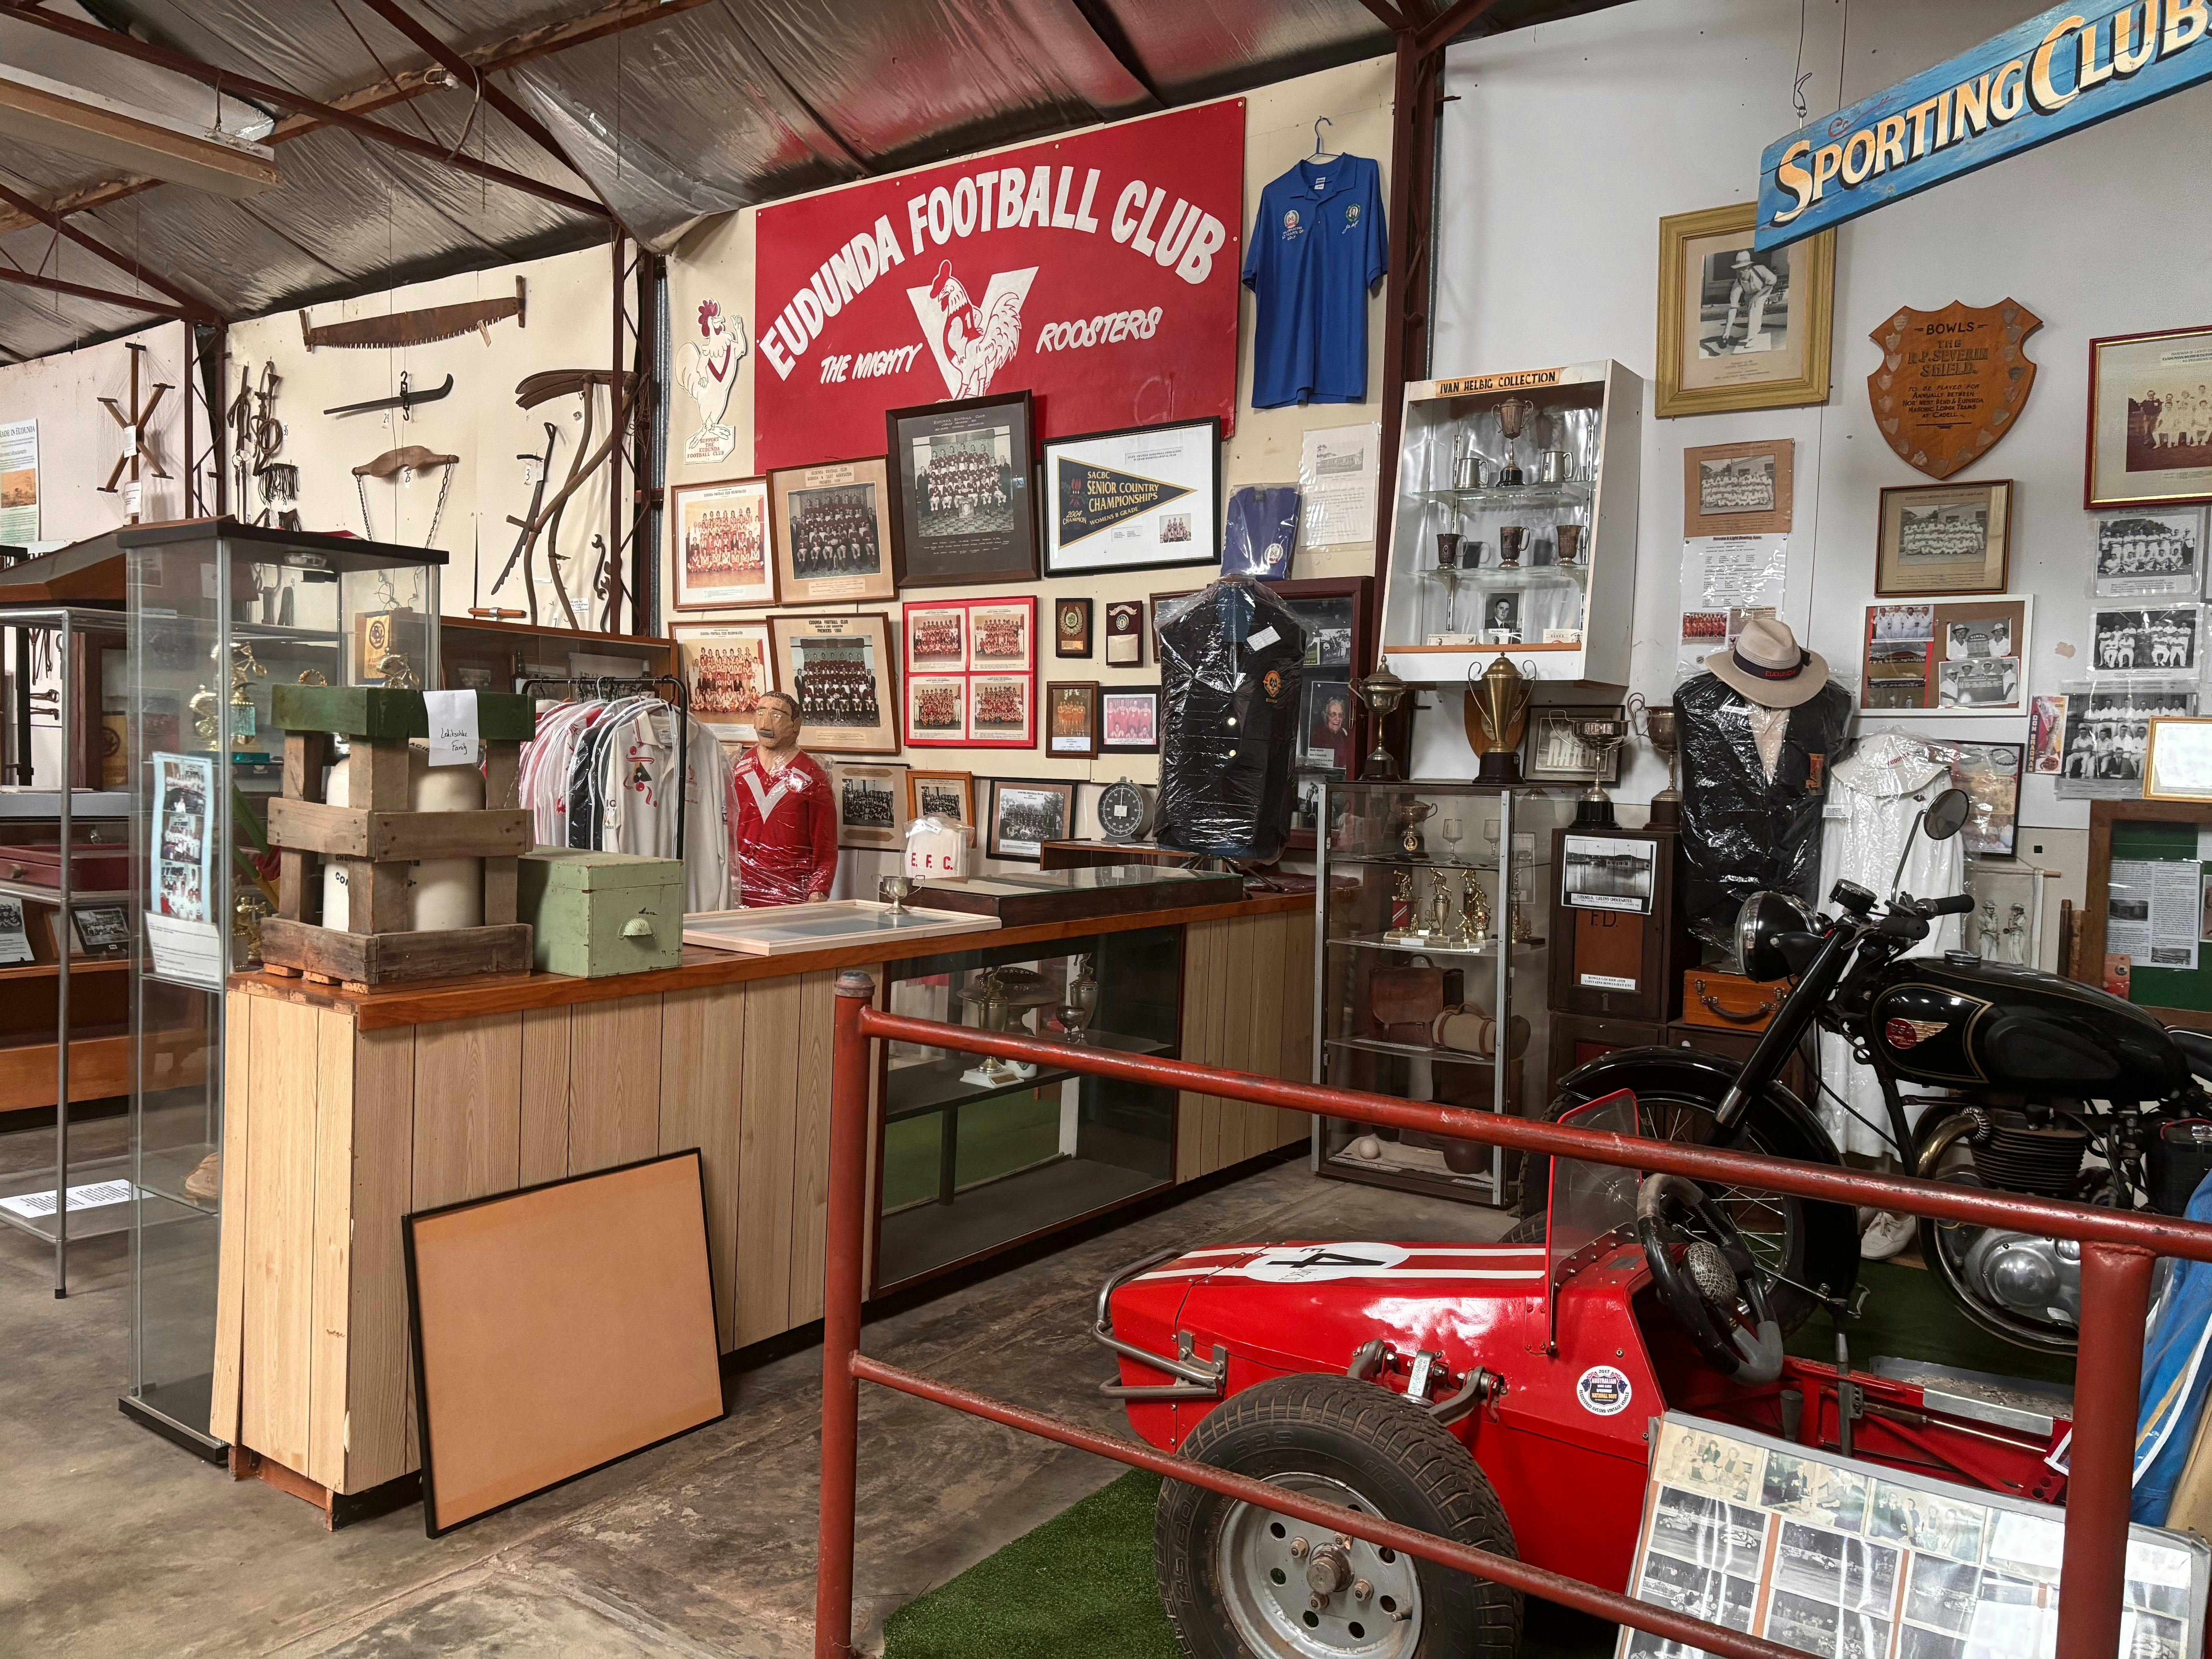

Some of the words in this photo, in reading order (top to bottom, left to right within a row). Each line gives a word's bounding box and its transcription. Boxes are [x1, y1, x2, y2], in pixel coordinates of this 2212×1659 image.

[1773, 60, 2023, 223] SPORTING
[2032, 0, 2212, 110] CLUB
[760, 215, 905, 381] EUDUNDA
[907, 165, 1101, 255] FOOTBALL
[1111, 180, 1226, 284] CLUB
[1036, 306, 1163, 354] ROOSTERS
[1927, 322, 1975, 335] BOWLS
[1937, 340, 1961, 348] THE
[821, 354, 847, 384] THE
[851, 343, 923, 380] MIGHTY
[1440, 382, 1459, 394] IVAN
[1464, 378, 1493, 391] HELBIG
[1498, 371, 1556, 387] COLLECTION
[1087, 480, 1117, 495] SENIOR
[1119, 482, 1159, 494] COUNTRY
[1089, 492, 1158, 512] CHAMPIONSHIPS
[1063, 517, 1087, 525] CHAMPION
[1089, 514, 1114, 526] WOMENS
[1120, 507, 1139, 517] GRADE
[409, 742, 429, 752] ACID
[1266, 1253, 1387, 1268] 4
[1607, 1404, 1622, 1413] VINTAGE
